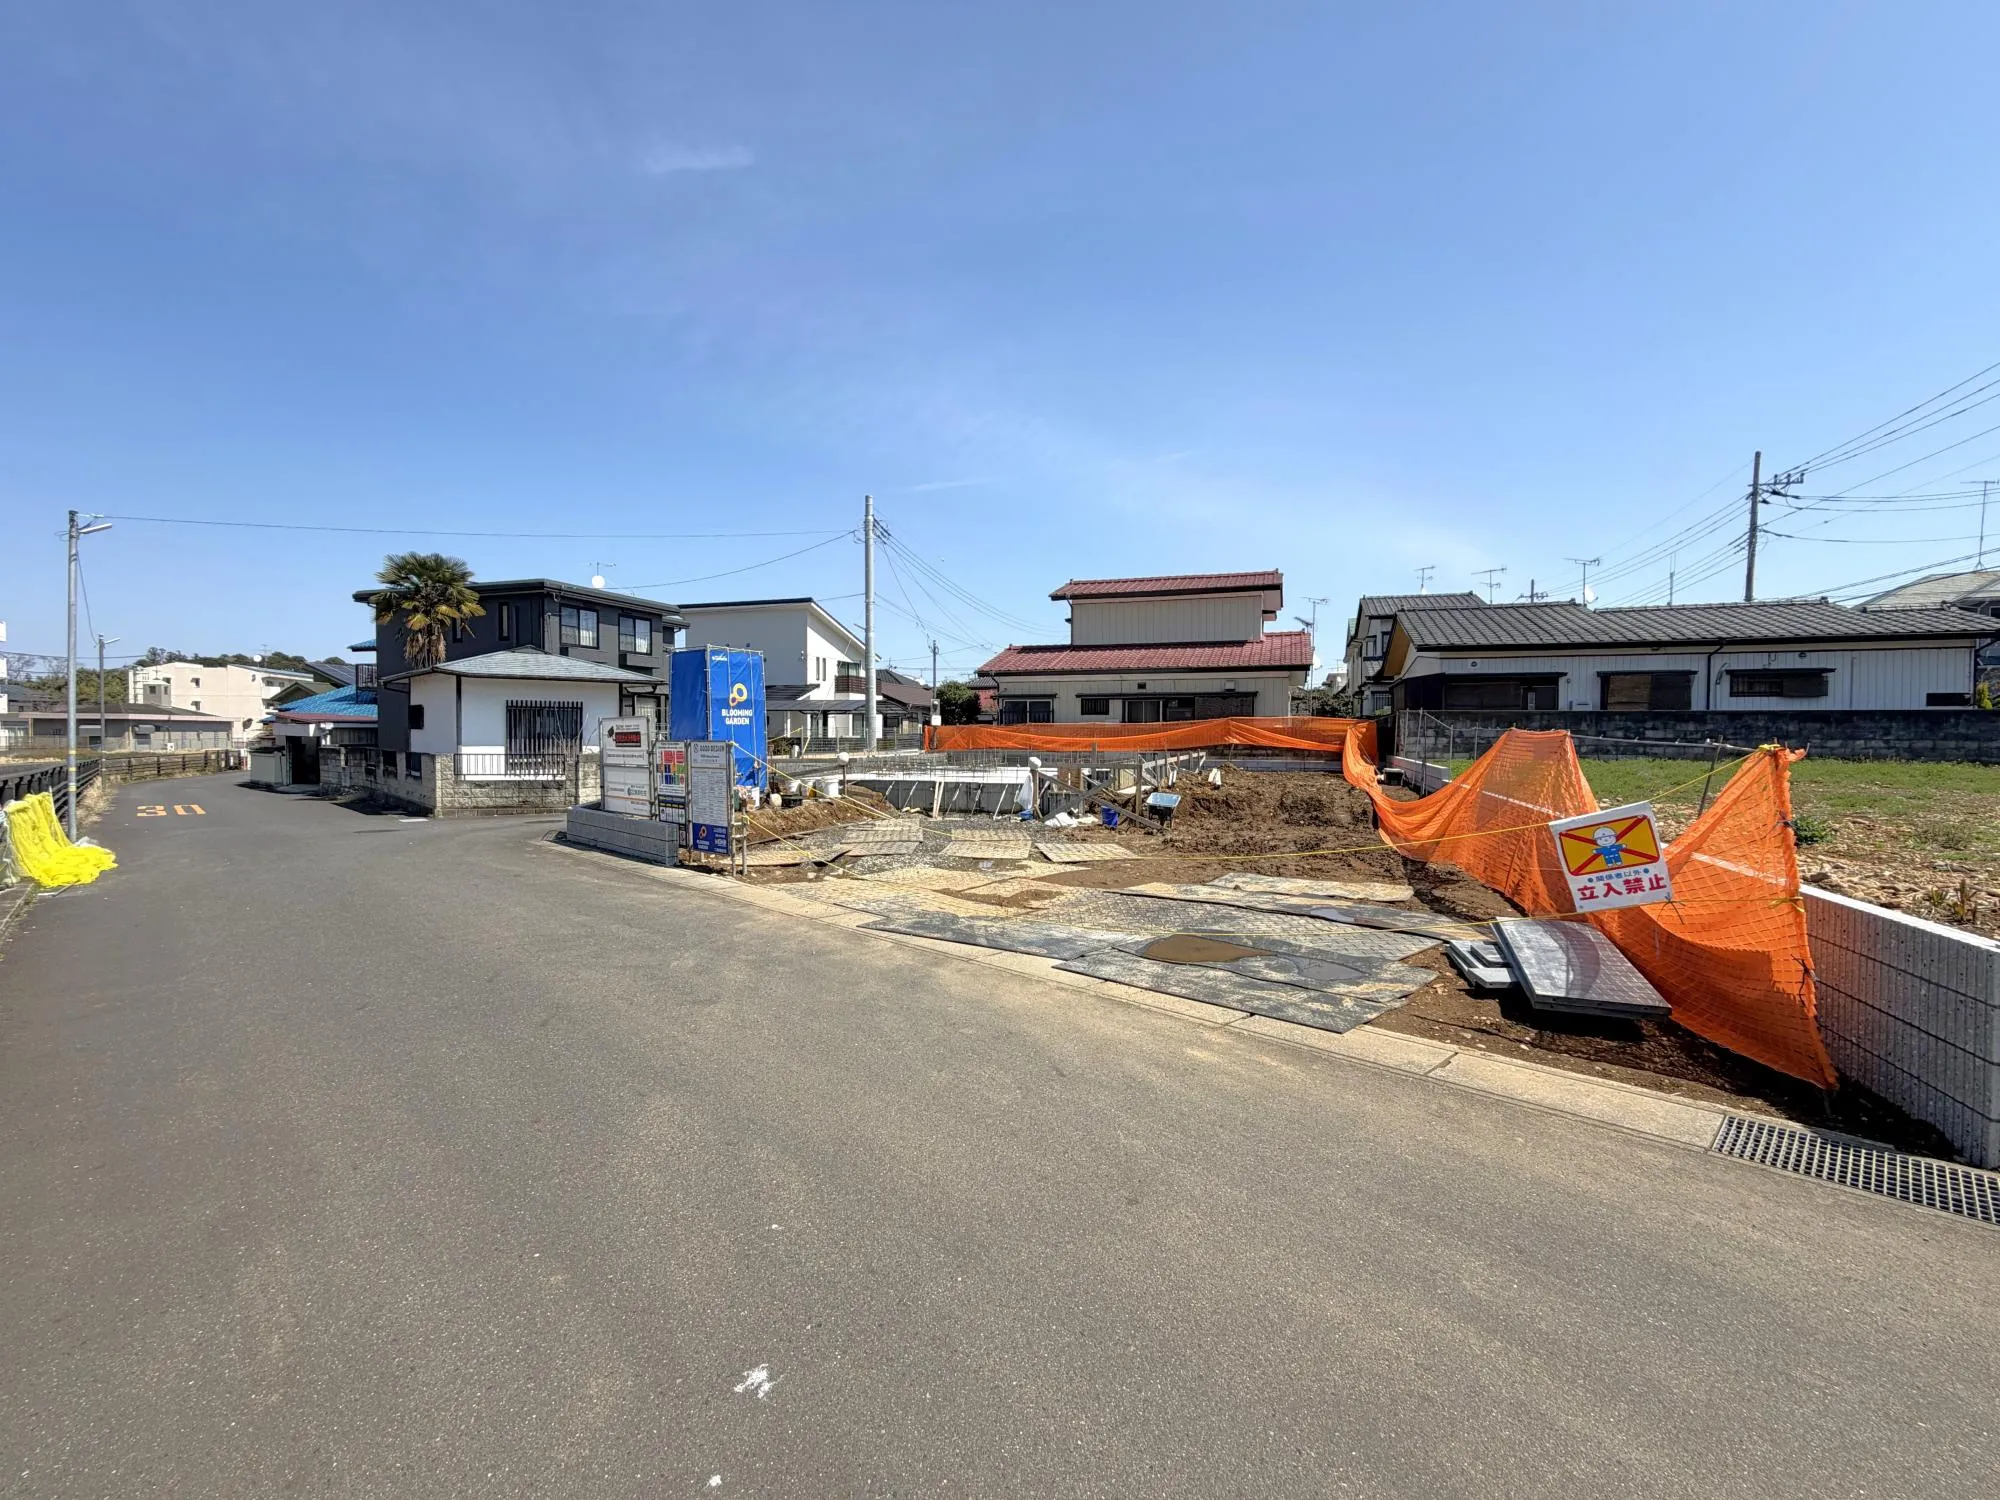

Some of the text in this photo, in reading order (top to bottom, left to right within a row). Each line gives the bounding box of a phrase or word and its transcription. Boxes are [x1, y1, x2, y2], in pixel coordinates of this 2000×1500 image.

[721, 709, 753, 717] BLOOMING
[725, 717, 750, 725] GARDEN
[136, 804, 207, 817] 30
[1577, 873, 1667, 901] 立入禁止
